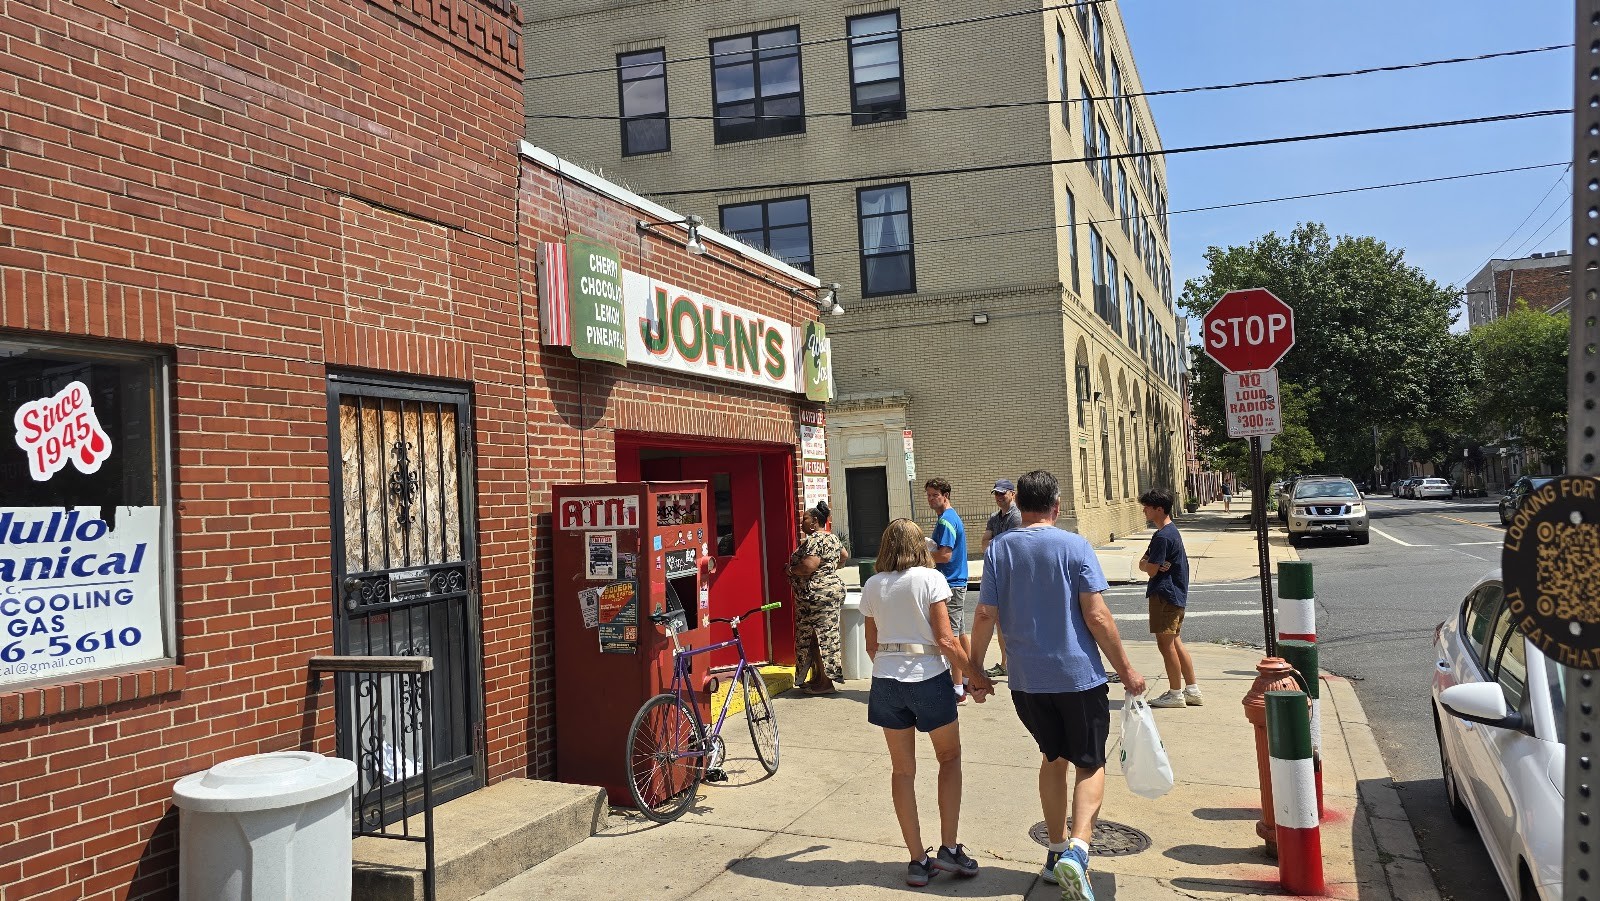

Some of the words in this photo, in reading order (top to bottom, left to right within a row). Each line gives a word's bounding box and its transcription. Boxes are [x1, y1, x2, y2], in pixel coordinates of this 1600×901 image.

[639, 286, 787, 381] JOHN'S
[1210, 313, 1287, 349] STOP
[1236, 389, 1267, 402] LOUD
[1239, 374, 1261, 388] NO
[23, 388, 83, 443] Since
[1230, 401, 1276, 414] RADIOS
[1237, 414, 1264, 428] $300
[37, 413, 90, 472] 1945
[562, 498, 637, 528] ATM
[1506, 484, 1557, 551] LOOKING
[1560, 479, 1595, 499] FOR
[0, 588, 134, 616] COOLING
[7, 614, 66, 637] GAS
[1507, 587, 1525, 614] TO
[1520, 615, 1553, 651] EAT
[0, 626, 142, 663] 6-5610
[0, 654, 96, 676] al@gmail.com
